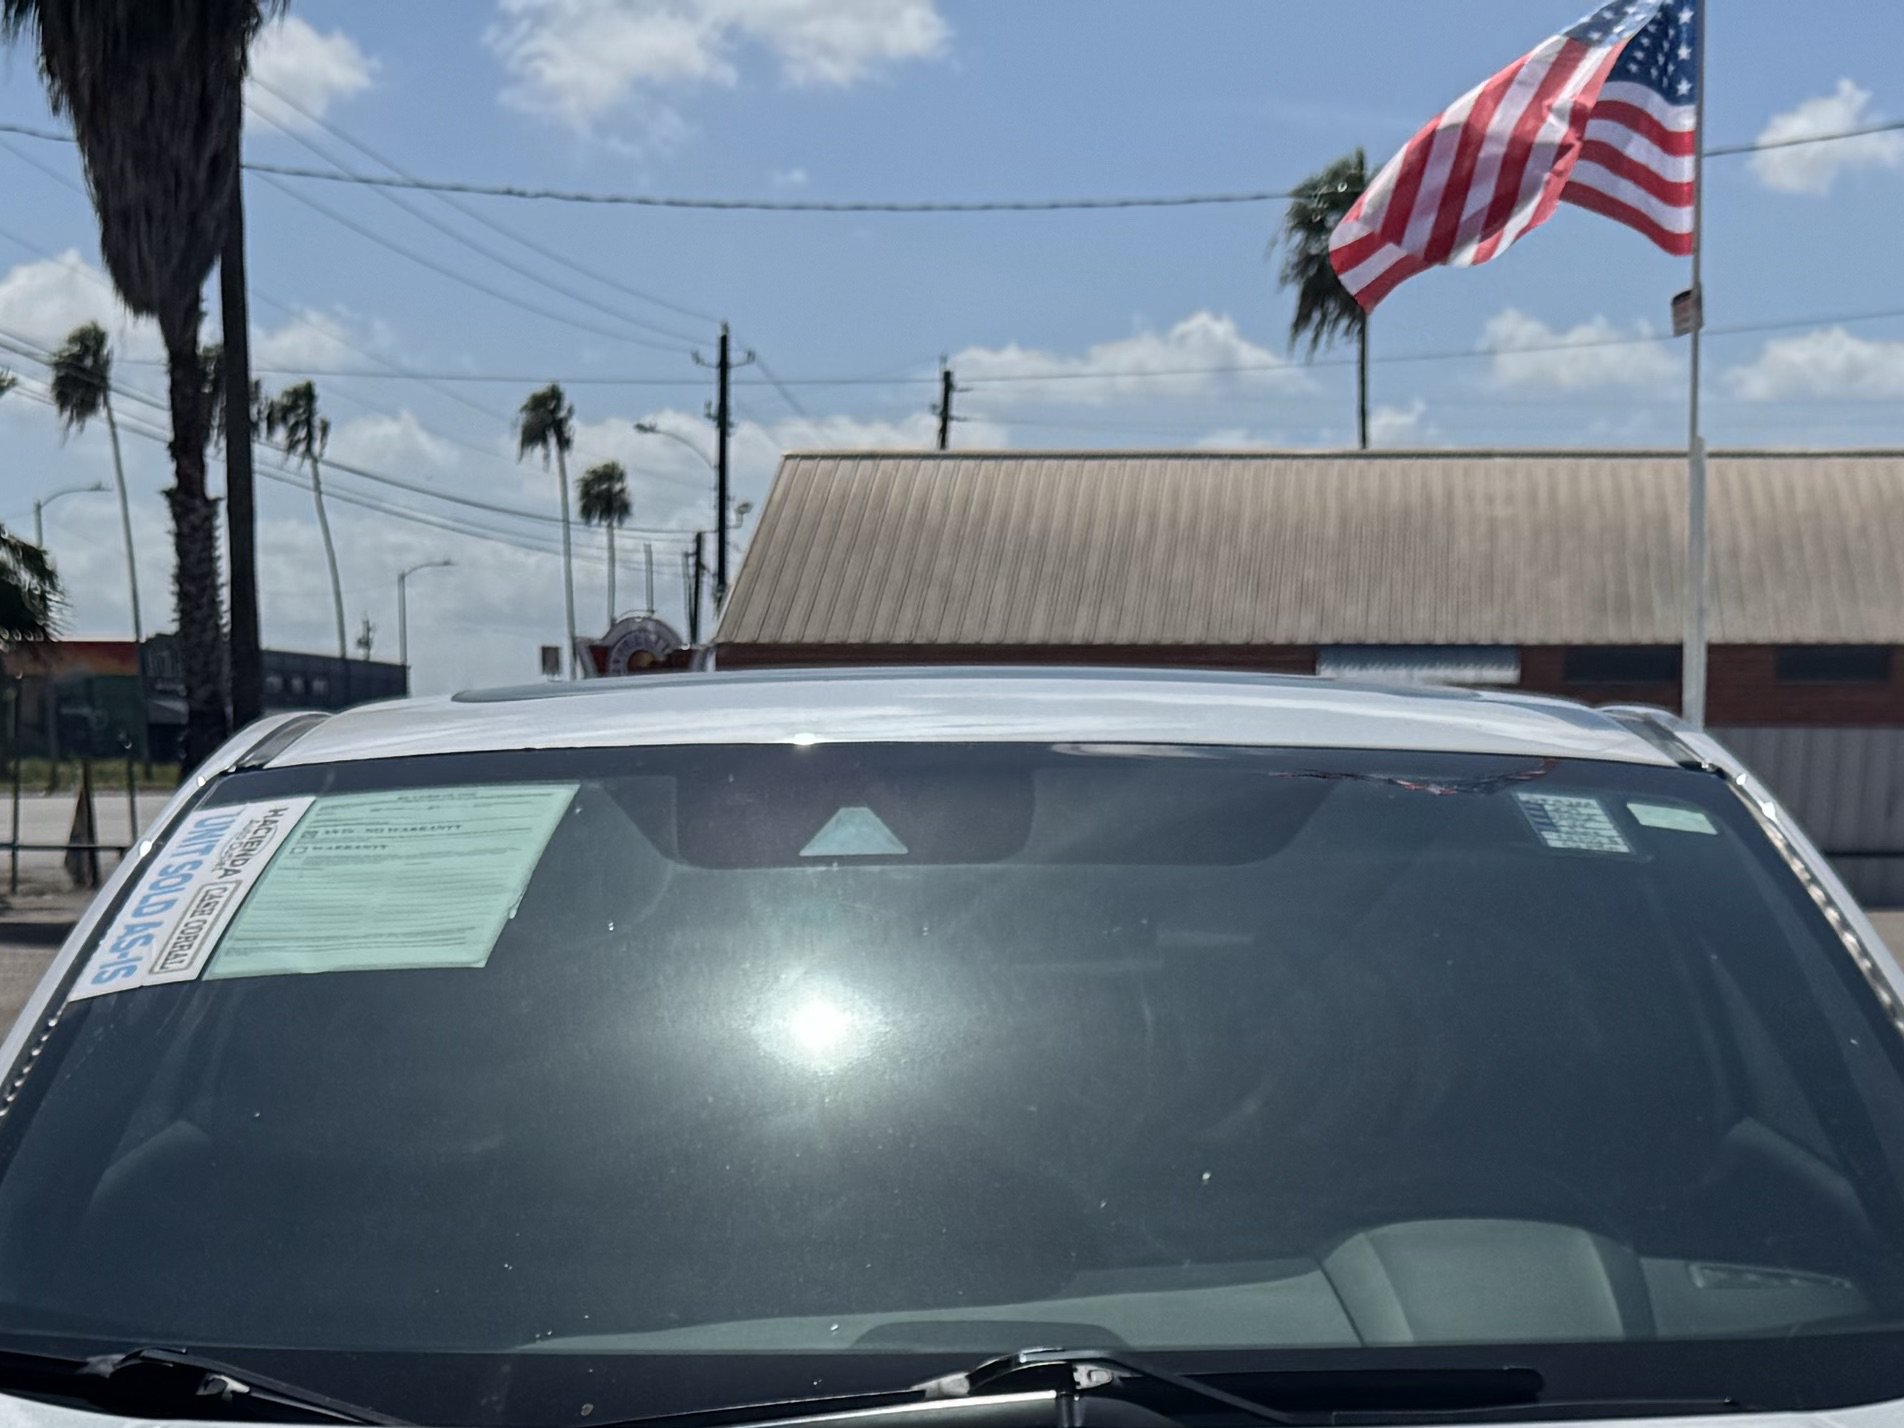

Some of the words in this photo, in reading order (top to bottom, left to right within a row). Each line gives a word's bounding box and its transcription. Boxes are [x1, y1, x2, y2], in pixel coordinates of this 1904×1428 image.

[176, 813, 234, 859] UNIT
[217, 807, 289, 879] HACIENDA
[132, 859, 201, 918] SOLD
[92, 921, 162, 985] AS-IS
